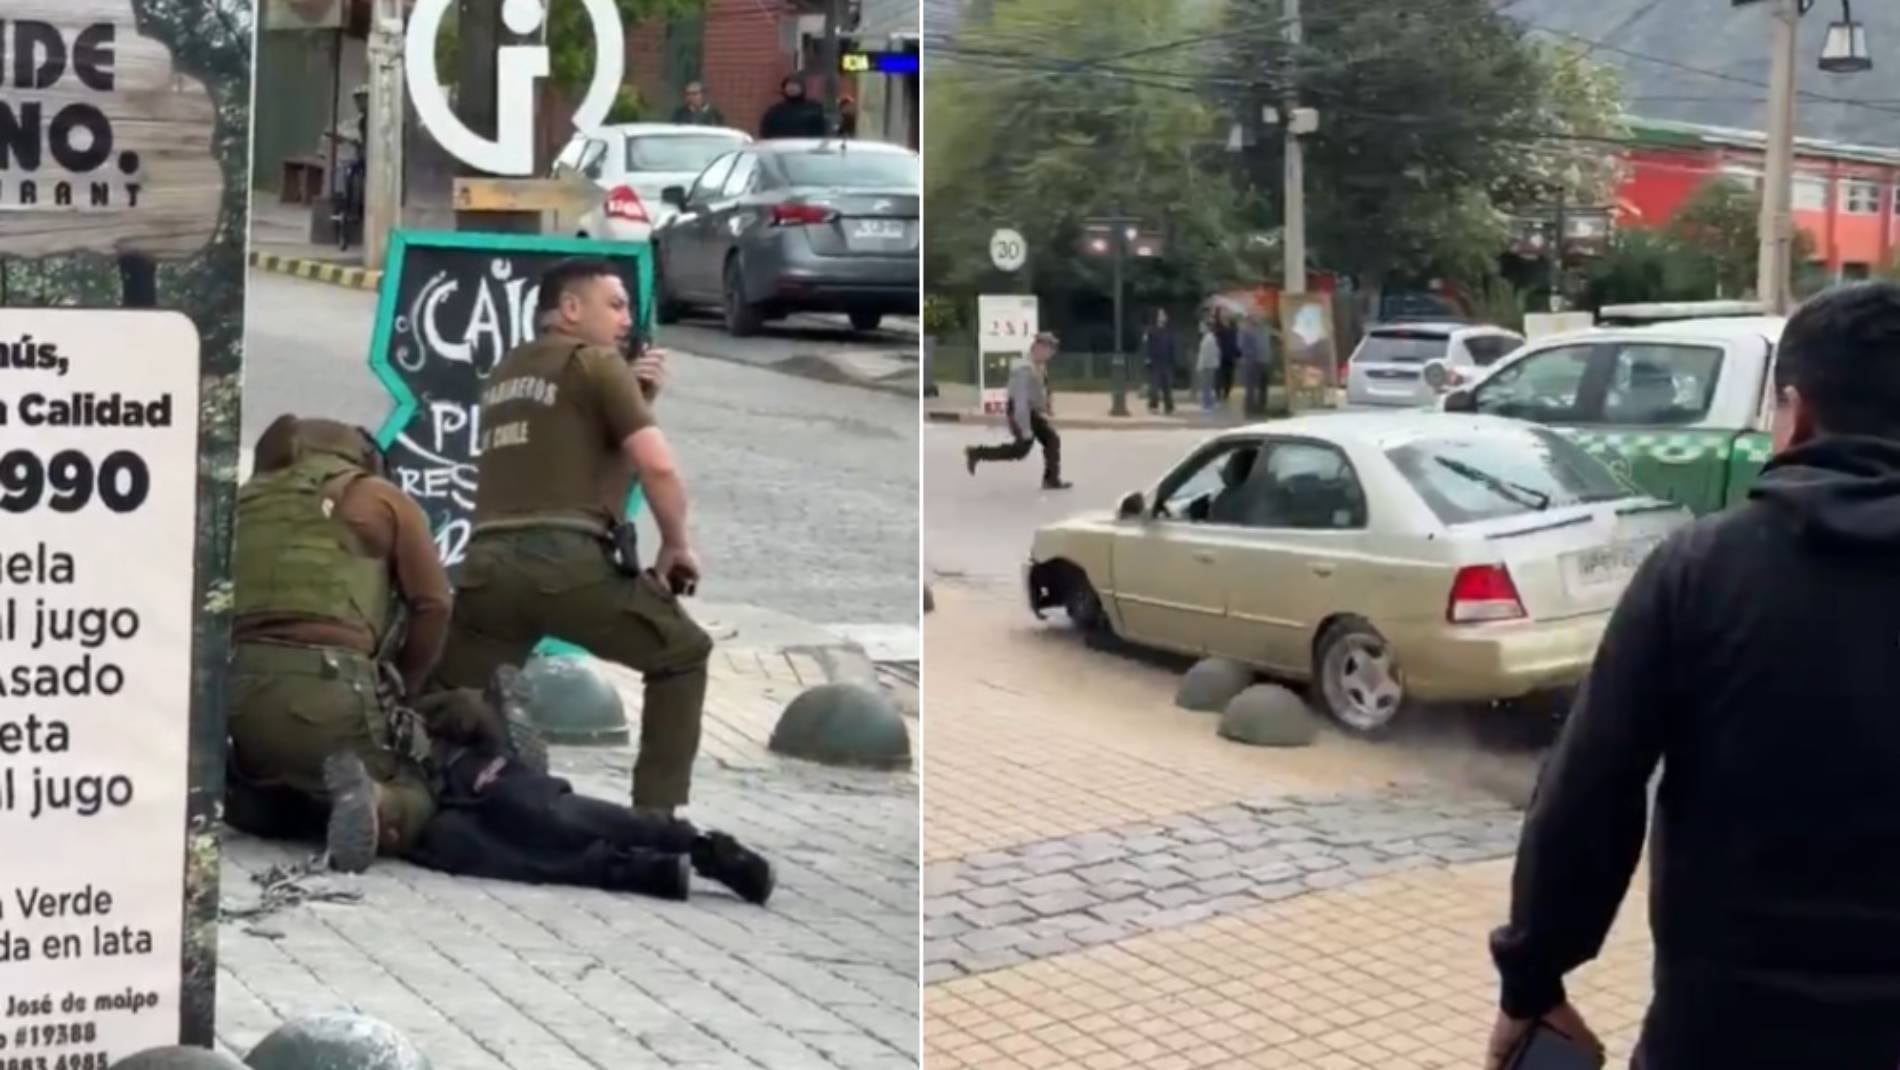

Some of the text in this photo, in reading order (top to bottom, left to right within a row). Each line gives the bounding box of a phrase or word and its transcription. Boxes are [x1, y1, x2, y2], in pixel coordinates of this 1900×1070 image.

[0, 19, 114, 91] DE
[0, 180, 141, 207] RANT
[998, 241, 1019, 260] 30
[18, 392, 172, 427] Calidad
[0, 448, 150, 514] 990
[0, 541, 75, 584] ela
[31, 598, 140, 649] jugo
[0, 653, 125, 697] sado
[30, 767, 133, 819] jugo
[15, 884, 113, 919] Verde
[42, 933, 81, 959] en
[93, 924, 153, 956] lata
[6, 993, 53, 1018] José
[61, 991, 87, 1013] de
